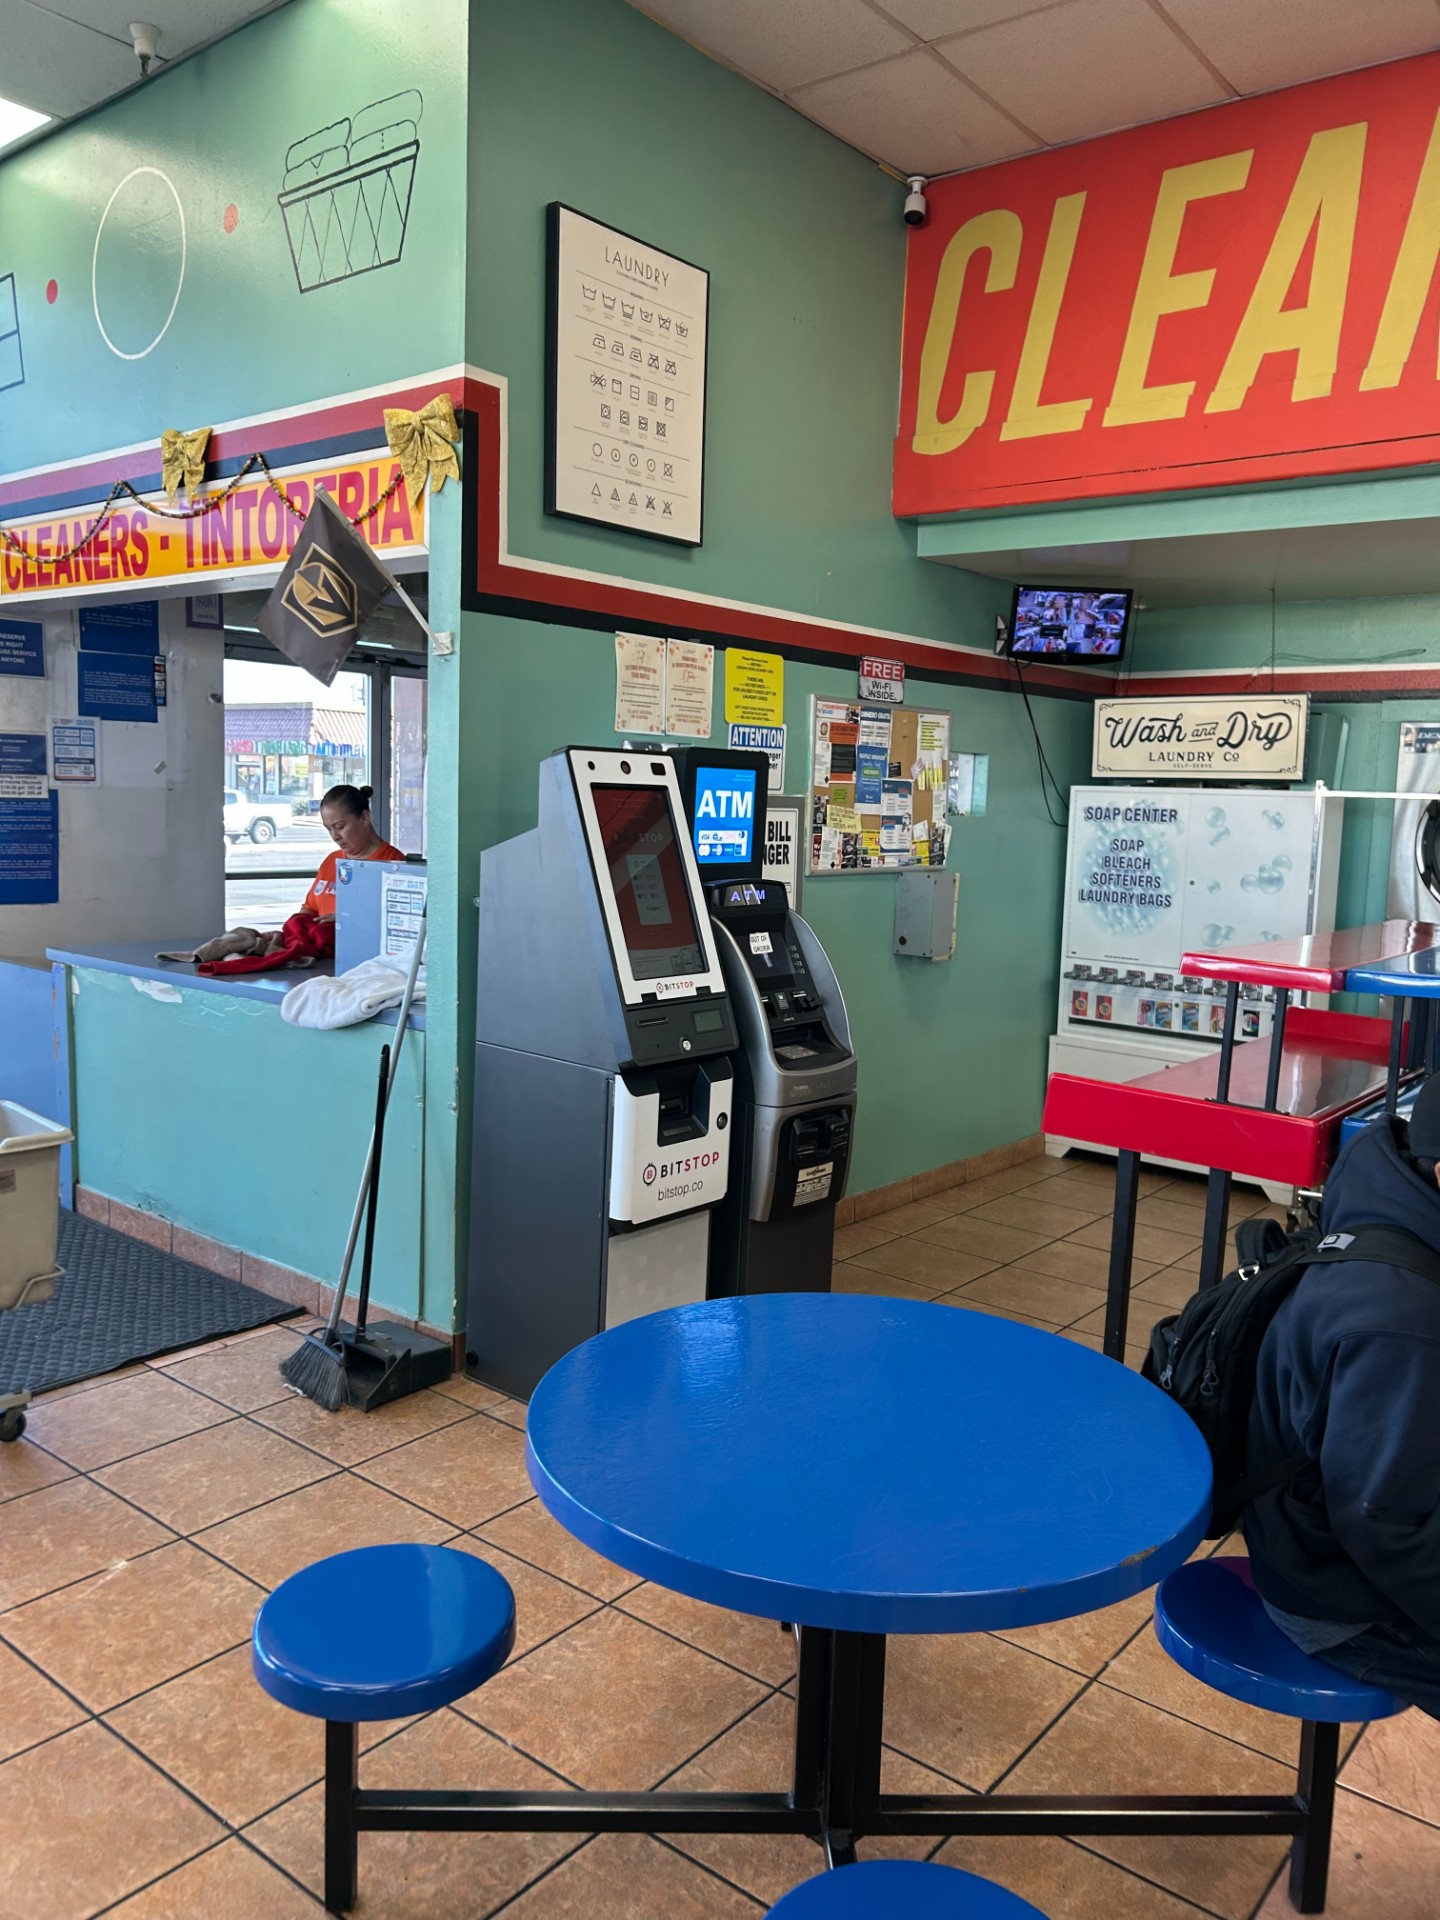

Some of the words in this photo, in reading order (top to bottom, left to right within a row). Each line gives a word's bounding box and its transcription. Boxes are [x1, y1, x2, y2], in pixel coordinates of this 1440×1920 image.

[605, 246, 669, 287] LAUNDRY
[912, 106, 1440, 455] CLEA
[5, 510, 149, 591] CLEANERS
[179, 463, 415, 568] TINTORRIA
[863, 661, 901, 680] FREE
[732, 726, 783, 748] ATTENTION
[1105, 713, 1187, 748] Wash
[1191, 722, 1219, 738] and
[1217, 711, 1293, 751] Dry
[1149, 752, 1215, 761] LAUNDRY
[697, 789, 752, 819] ATM
[1086, 807, 1121, 820] SOAP
[1124, 808, 1178, 823] CENTER
[768, 821, 791, 842] BILL
[1112, 839, 1144, 851] SOAP
[1104, 856, 1151, 870] BLEACH
[1091, 872, 1161, 889] SOFTENERS
[731, 889, 766, 902] ATM
[1080, 889, 1135, 904] LAUNDRY
[1139, 893, 1172, 907] BAGS
[751, 935, 760, 943] OUT
[753, 944, 771, 953] ORDER
[665, 981, 693, 991] BITSTOP
[661, 1152, 719, 1178] BITSTOP
[658, 1181, 703, 1201] bitstop.co
